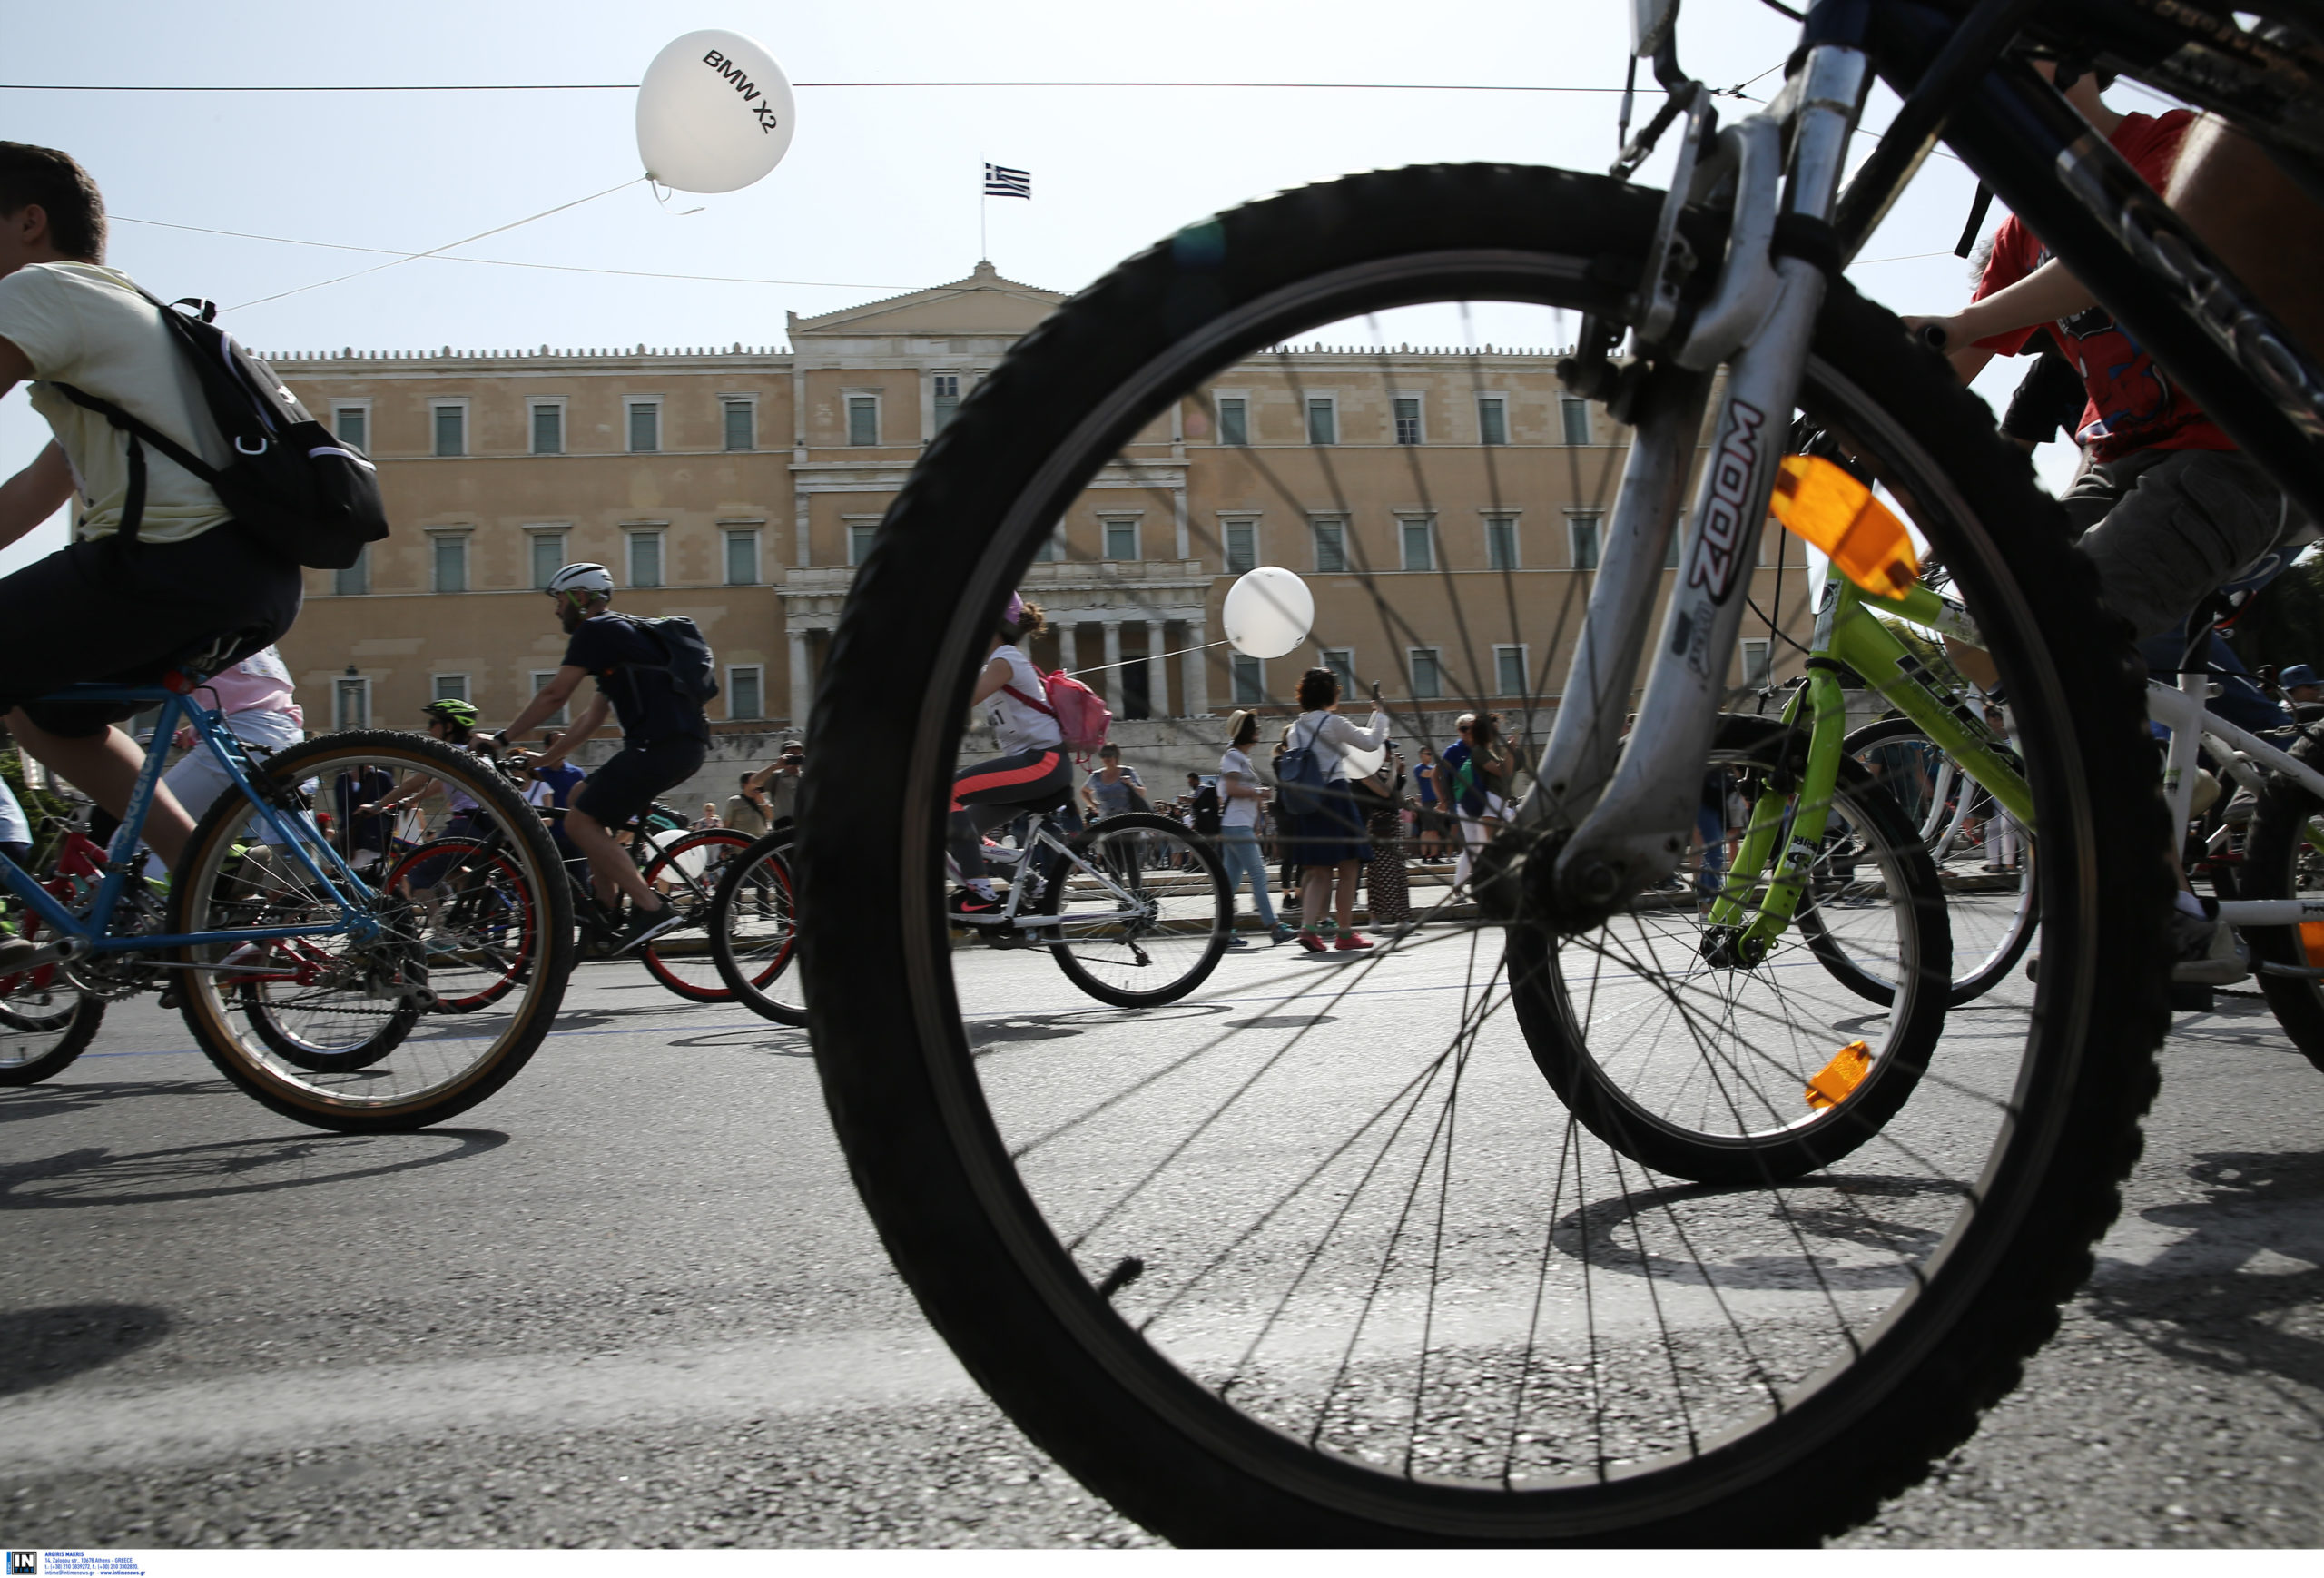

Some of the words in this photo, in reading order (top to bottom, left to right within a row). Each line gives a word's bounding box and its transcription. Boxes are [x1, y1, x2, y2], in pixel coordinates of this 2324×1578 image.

[702, 49, 762, 102] BMW
[752, 99, 777, 134] X2
[1689, 399, 1764, 602] ZOOM
